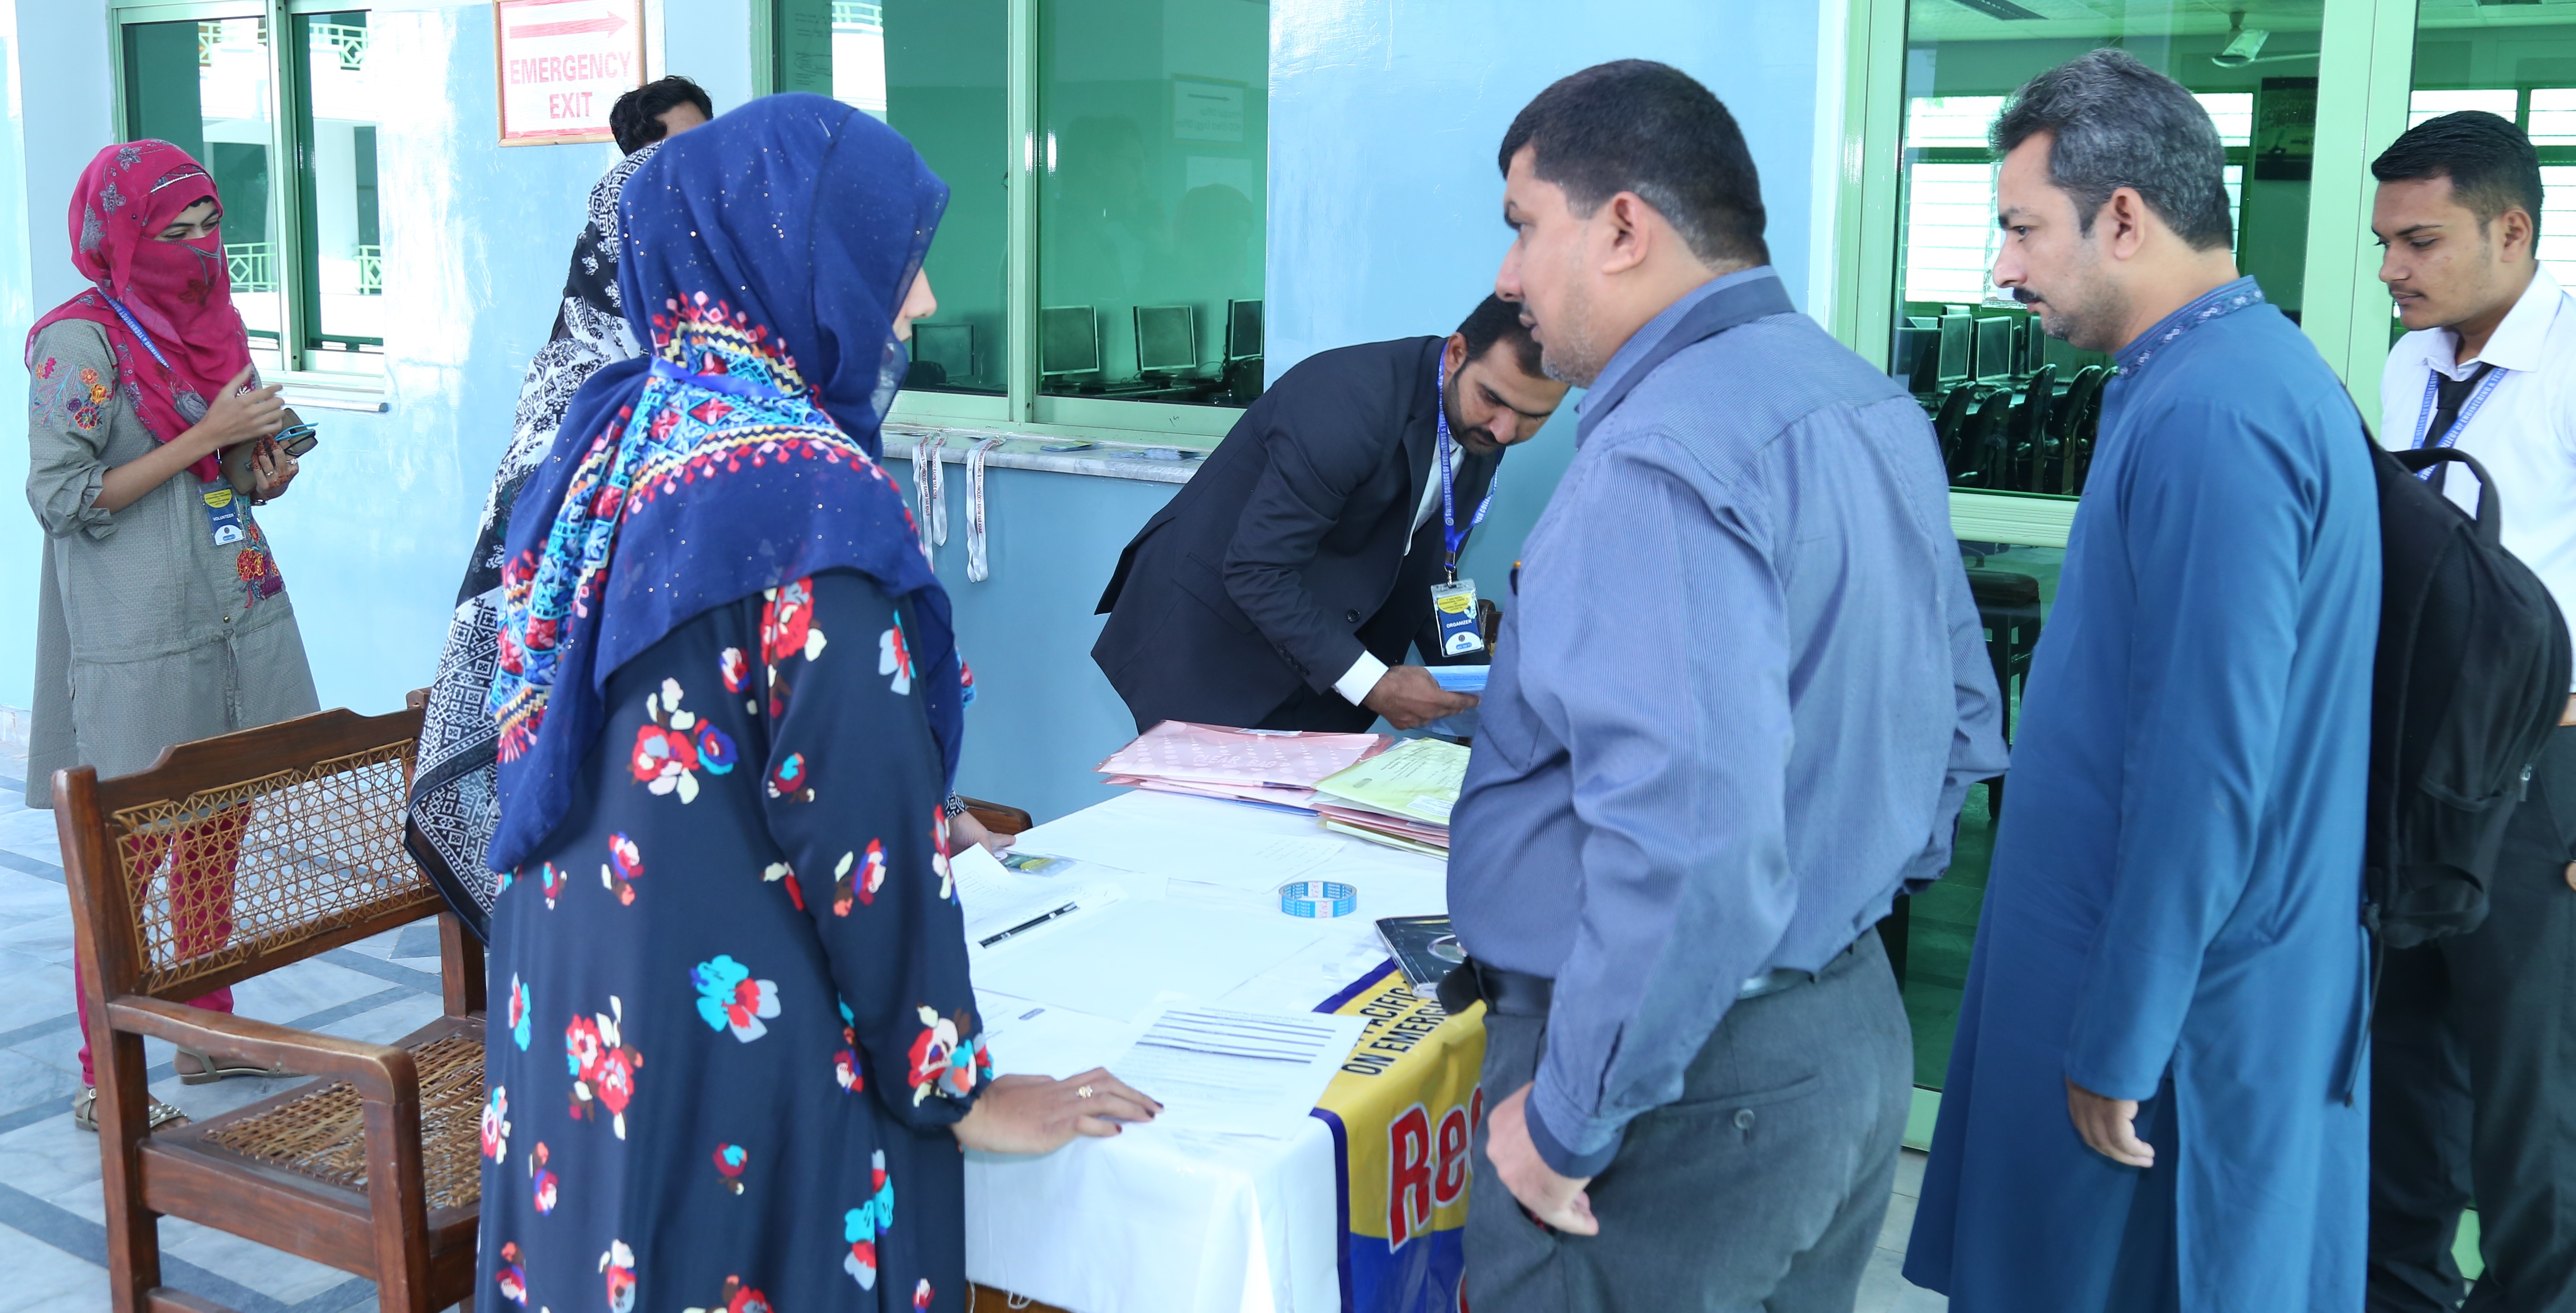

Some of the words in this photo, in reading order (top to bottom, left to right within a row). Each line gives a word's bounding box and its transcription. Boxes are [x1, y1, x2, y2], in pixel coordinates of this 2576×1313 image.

[510, 51, 631, 84] EMERGENCY
[549, 92, 593, 119] EXIT
[118, 310, 145, 339] TECHNOLOGY
[2456, 422, 2464, 431] OF
[2461, 387, 2492, 424] ENGINEERING
[1441, 433, 1449, 466] ENGINEERING
[213, 513, 234, 521] VOLUNTEER
[1446, 619, 1472, 628] ORGANIZER
[1193, 754, 1241, 764] CLEAR
[1246, 759, 1278, 768] BAG
[1359, 987, 1418, 1034] ACIFIC
[1341, 1052, 1396, 1075] ON
